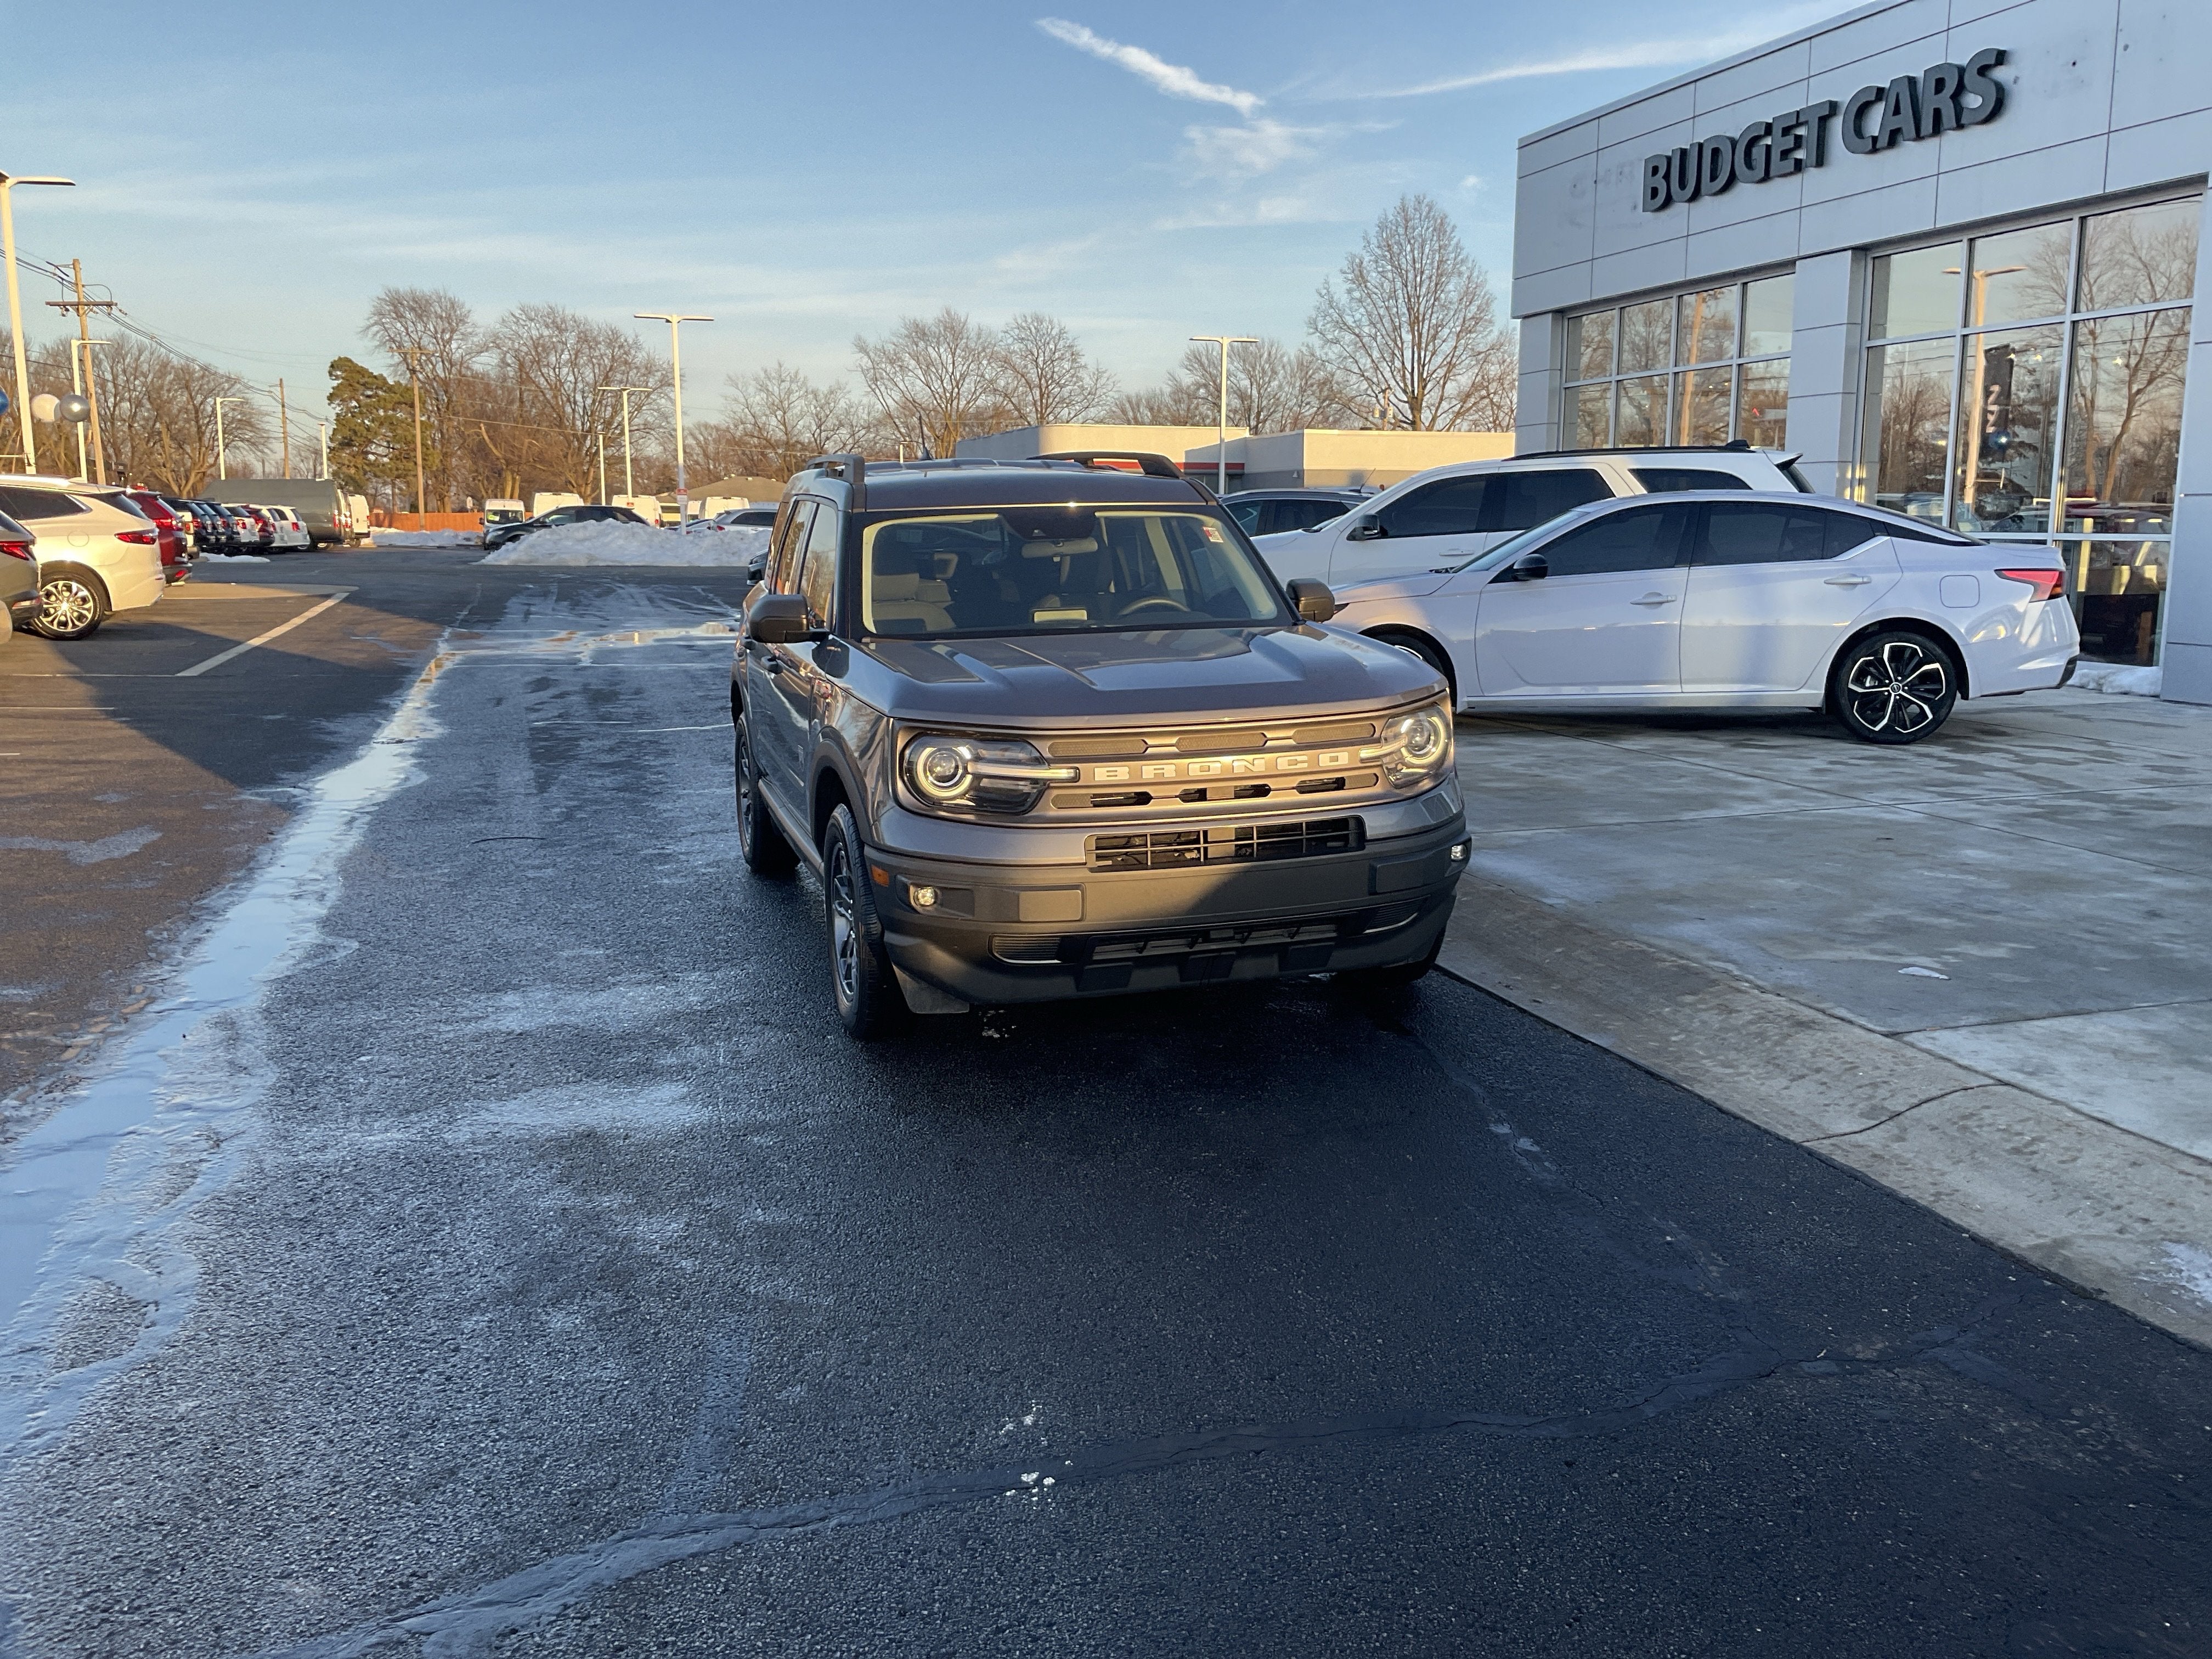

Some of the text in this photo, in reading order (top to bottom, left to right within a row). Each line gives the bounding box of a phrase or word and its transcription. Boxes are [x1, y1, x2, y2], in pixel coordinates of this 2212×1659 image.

[1643, 48, 2007, 212] BUDGET CARS
[1093, 751, 1348, 781] BRONCO
